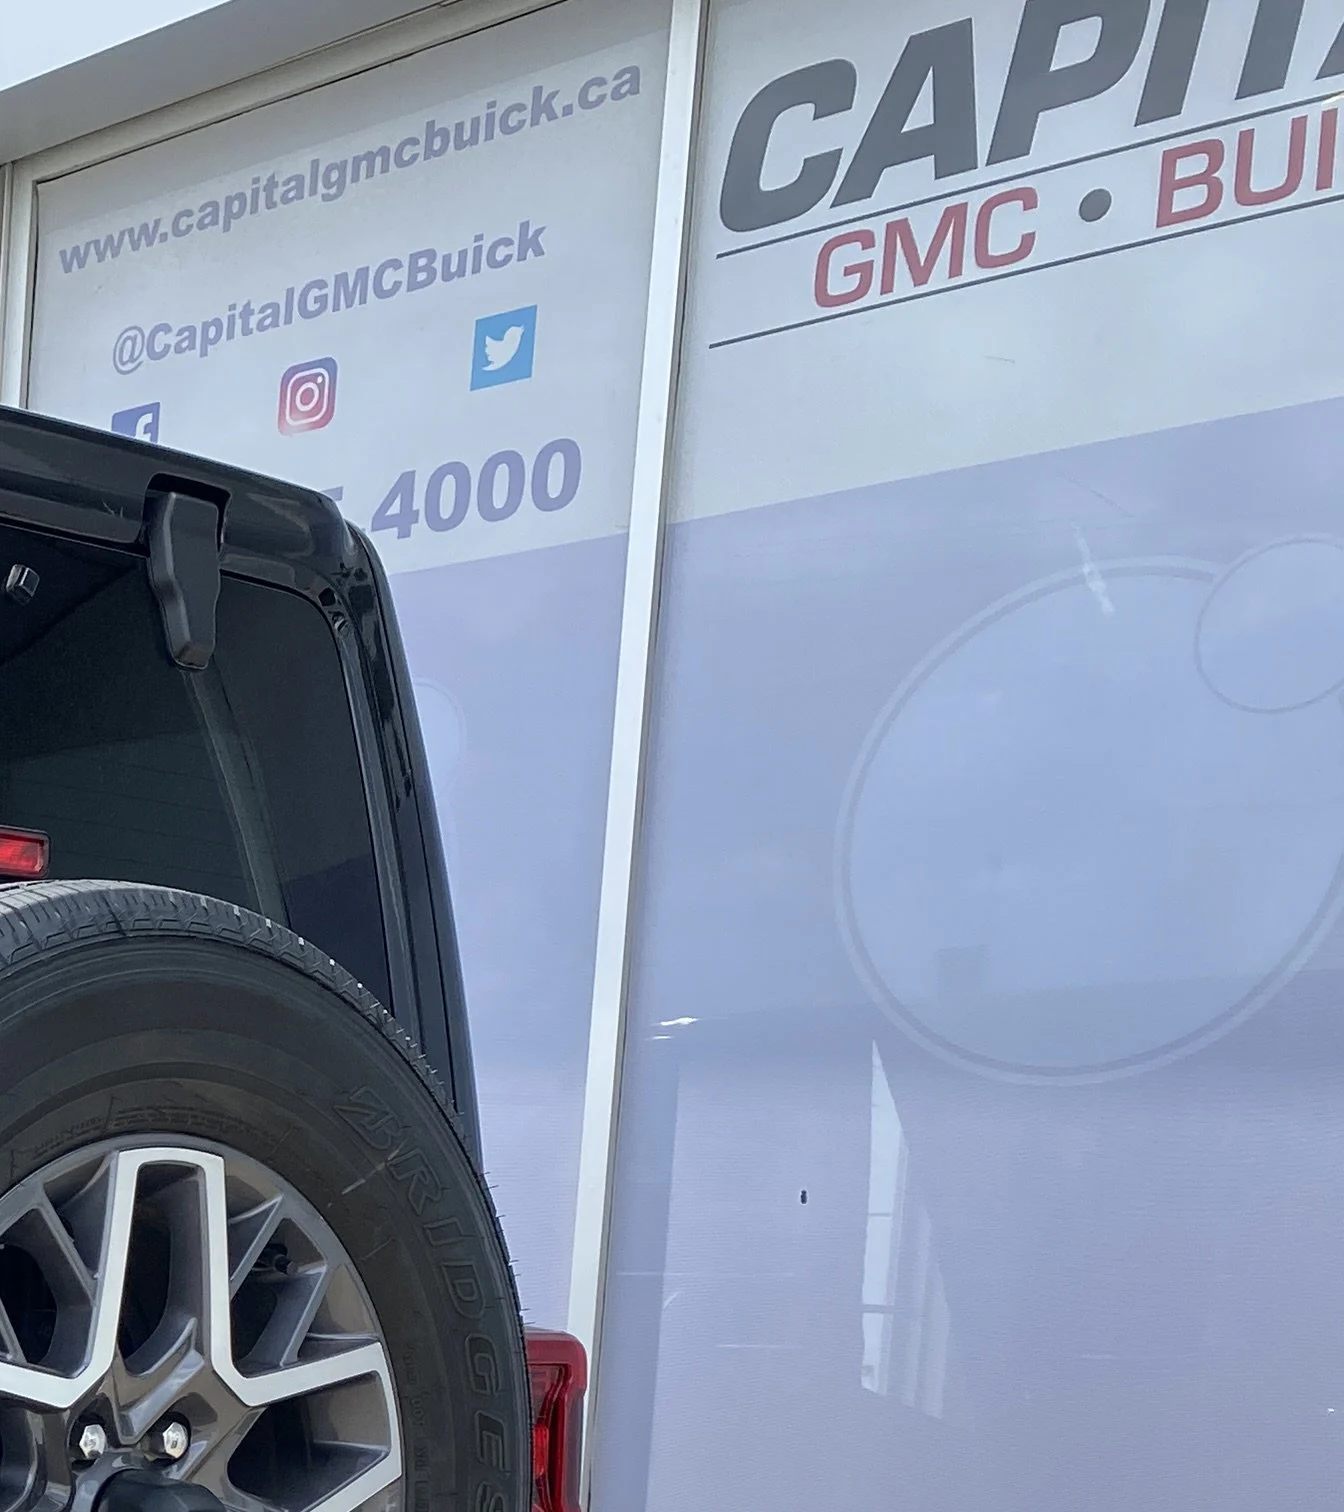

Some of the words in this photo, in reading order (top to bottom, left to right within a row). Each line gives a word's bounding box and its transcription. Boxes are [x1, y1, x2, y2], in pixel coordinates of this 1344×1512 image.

[58, 62, 642, 275] www.capitalgmcbuick.ca
[719, 0, 1344, 233] CAPI
[112, 218, 547, 376] @CapitalGMCBuick
[814, 185, 1039, 309] GMC
[320, 437, 583, 541] 4000
